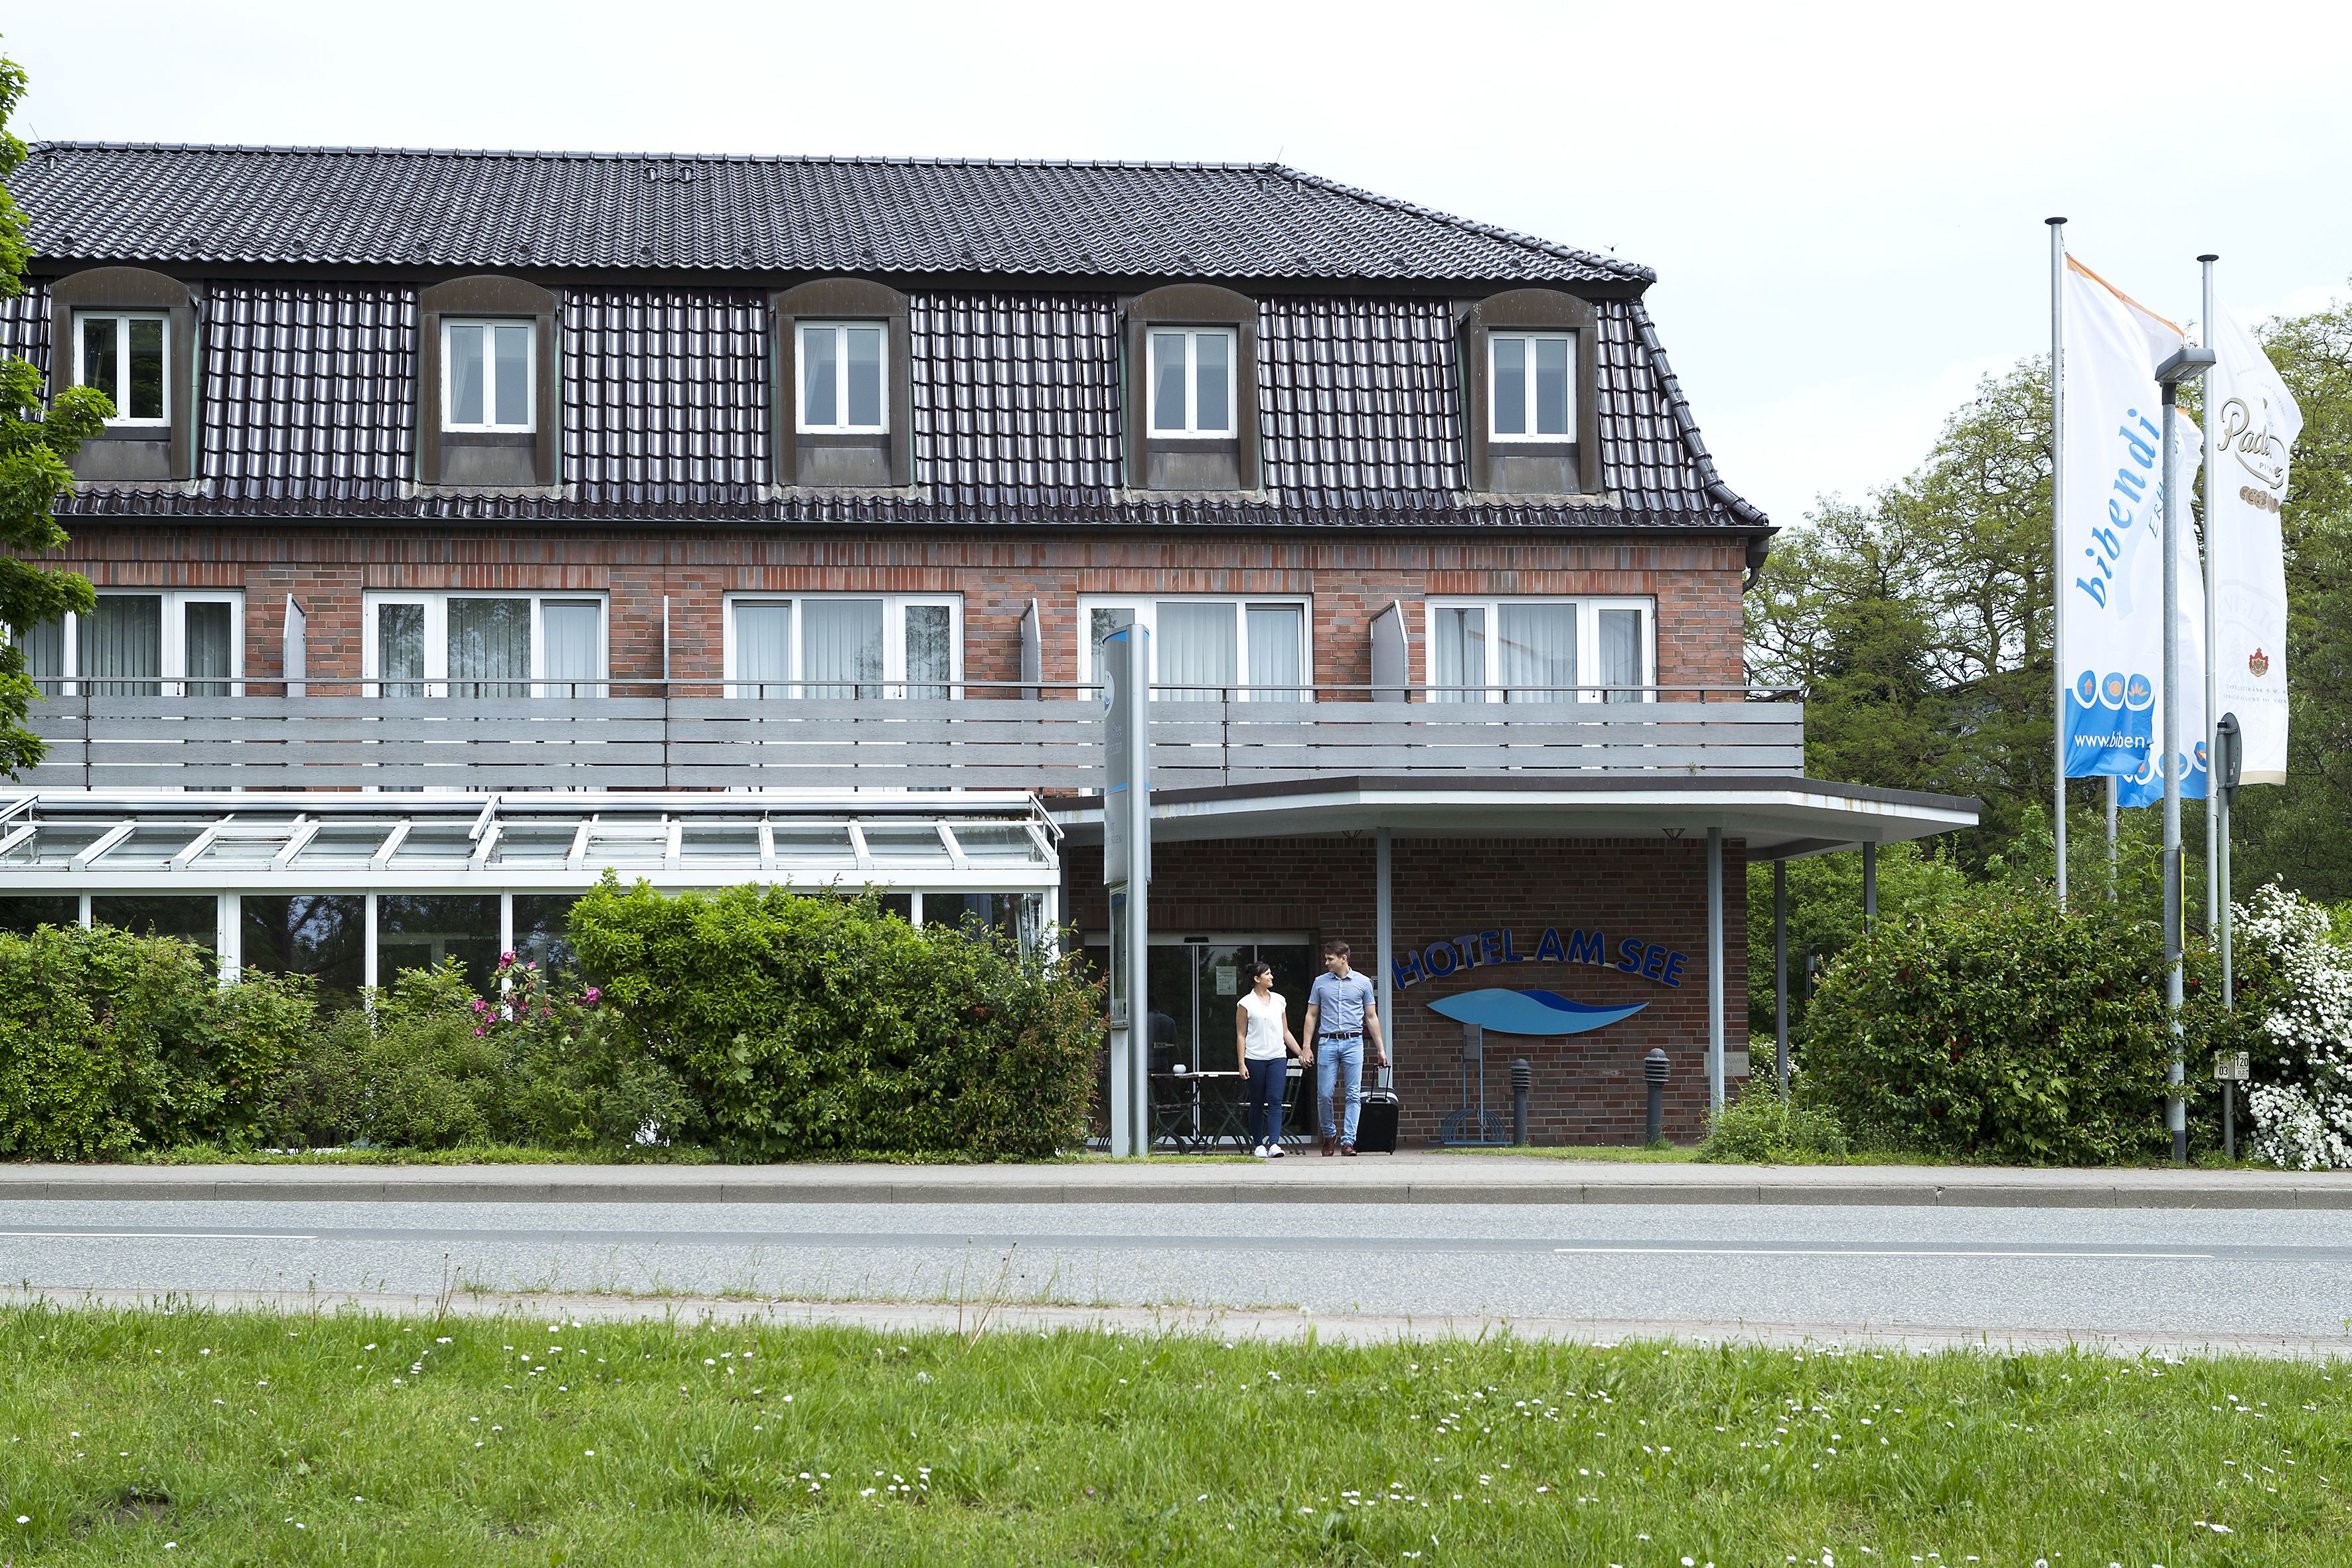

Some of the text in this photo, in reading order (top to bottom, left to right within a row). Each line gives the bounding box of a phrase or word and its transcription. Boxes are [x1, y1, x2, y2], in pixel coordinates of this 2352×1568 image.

[2076, 408, 2159, 609] bibendi
[1391, 927, 1689, 990] HOTEL AM SEE
[2219, 1066, 2228, 1075] 03
[2236, 1058, 2248, 1067] 120
